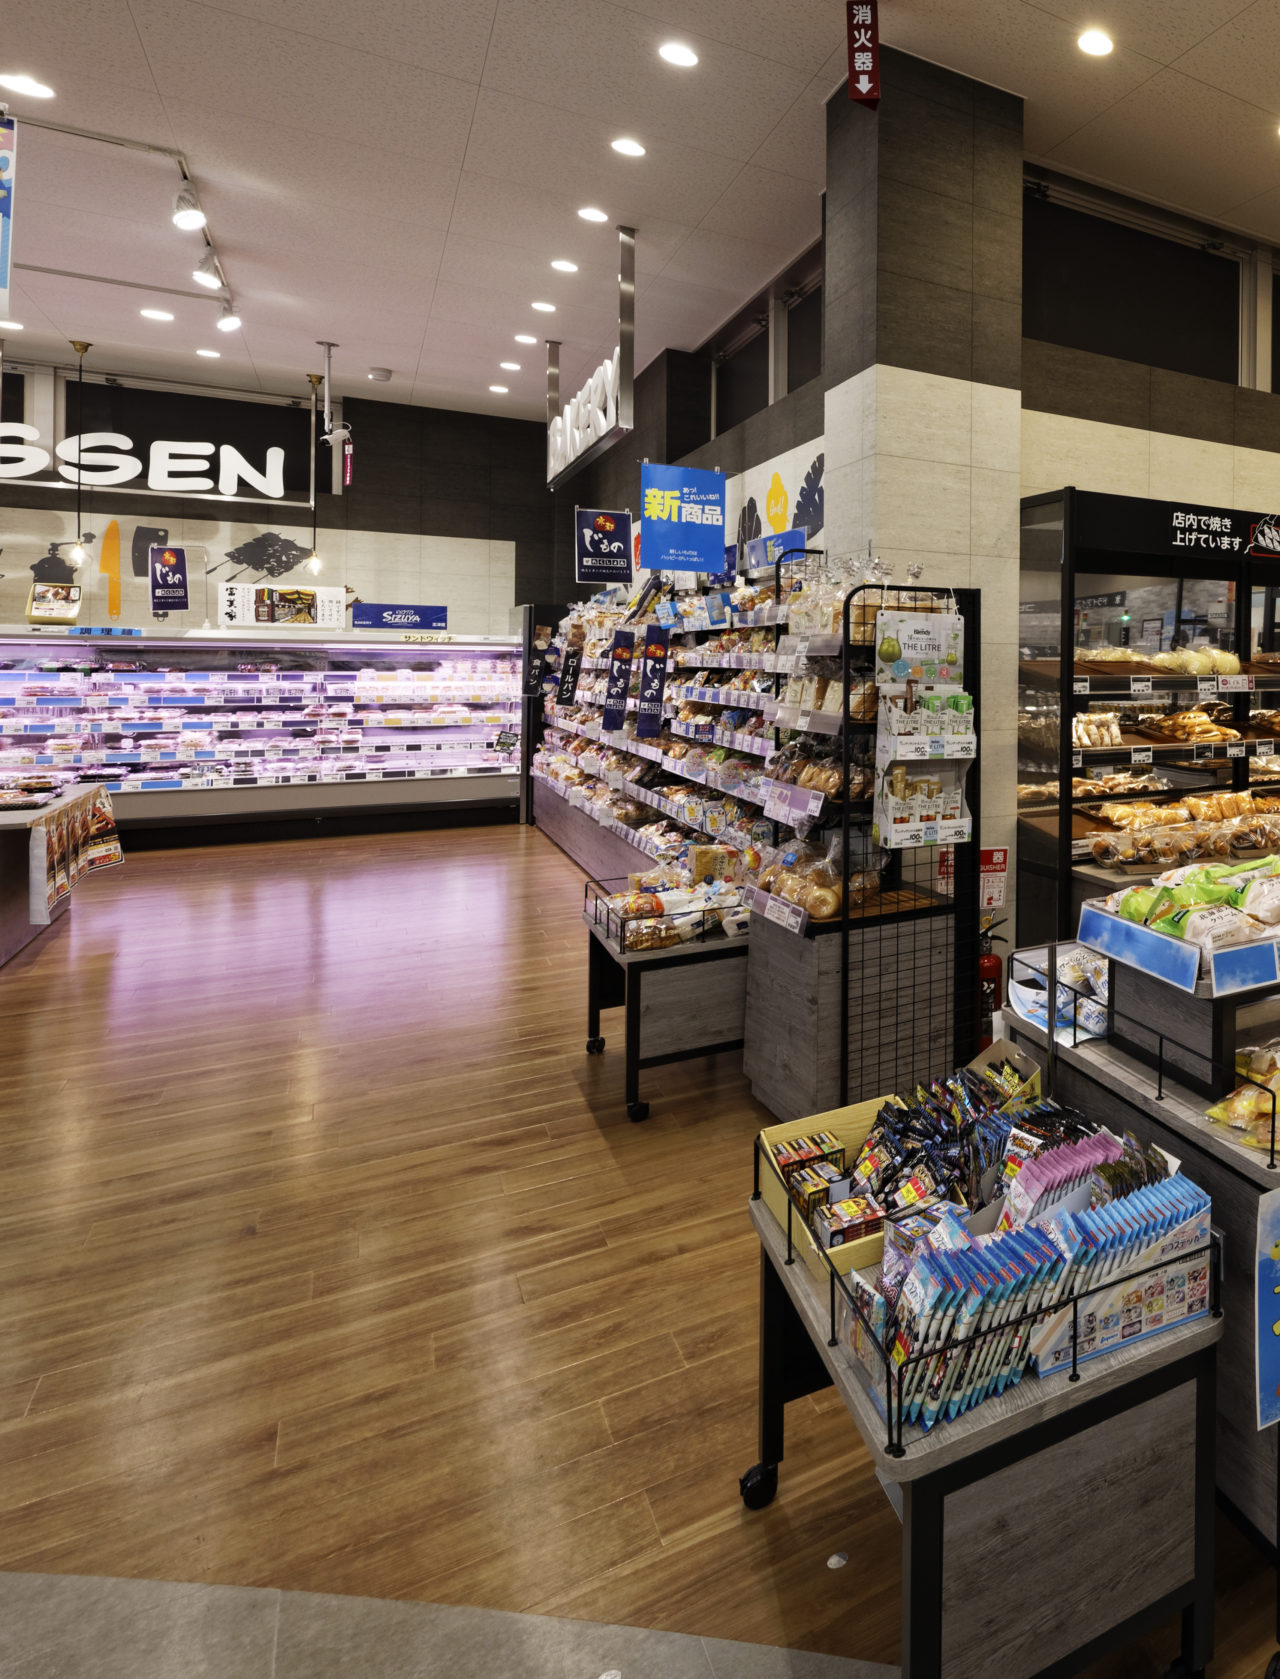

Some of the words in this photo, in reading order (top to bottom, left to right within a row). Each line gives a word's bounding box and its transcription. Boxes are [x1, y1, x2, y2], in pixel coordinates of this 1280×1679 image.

[853, 5, 874, 71] 消火器
[643, 488, 723, 525] 新商品
[1172, 512, 1232, 533] 店内で焼き
[1172, 531, 1242, 551] 上げています
[382, 611, 421, 624] SIZUYA
[902, 642, 918, 651] THE
[920, 643, 942, 652] LITRE
[529, 658, 541, 685] 食パン
[561, 658, 576, 698] ロールパン
